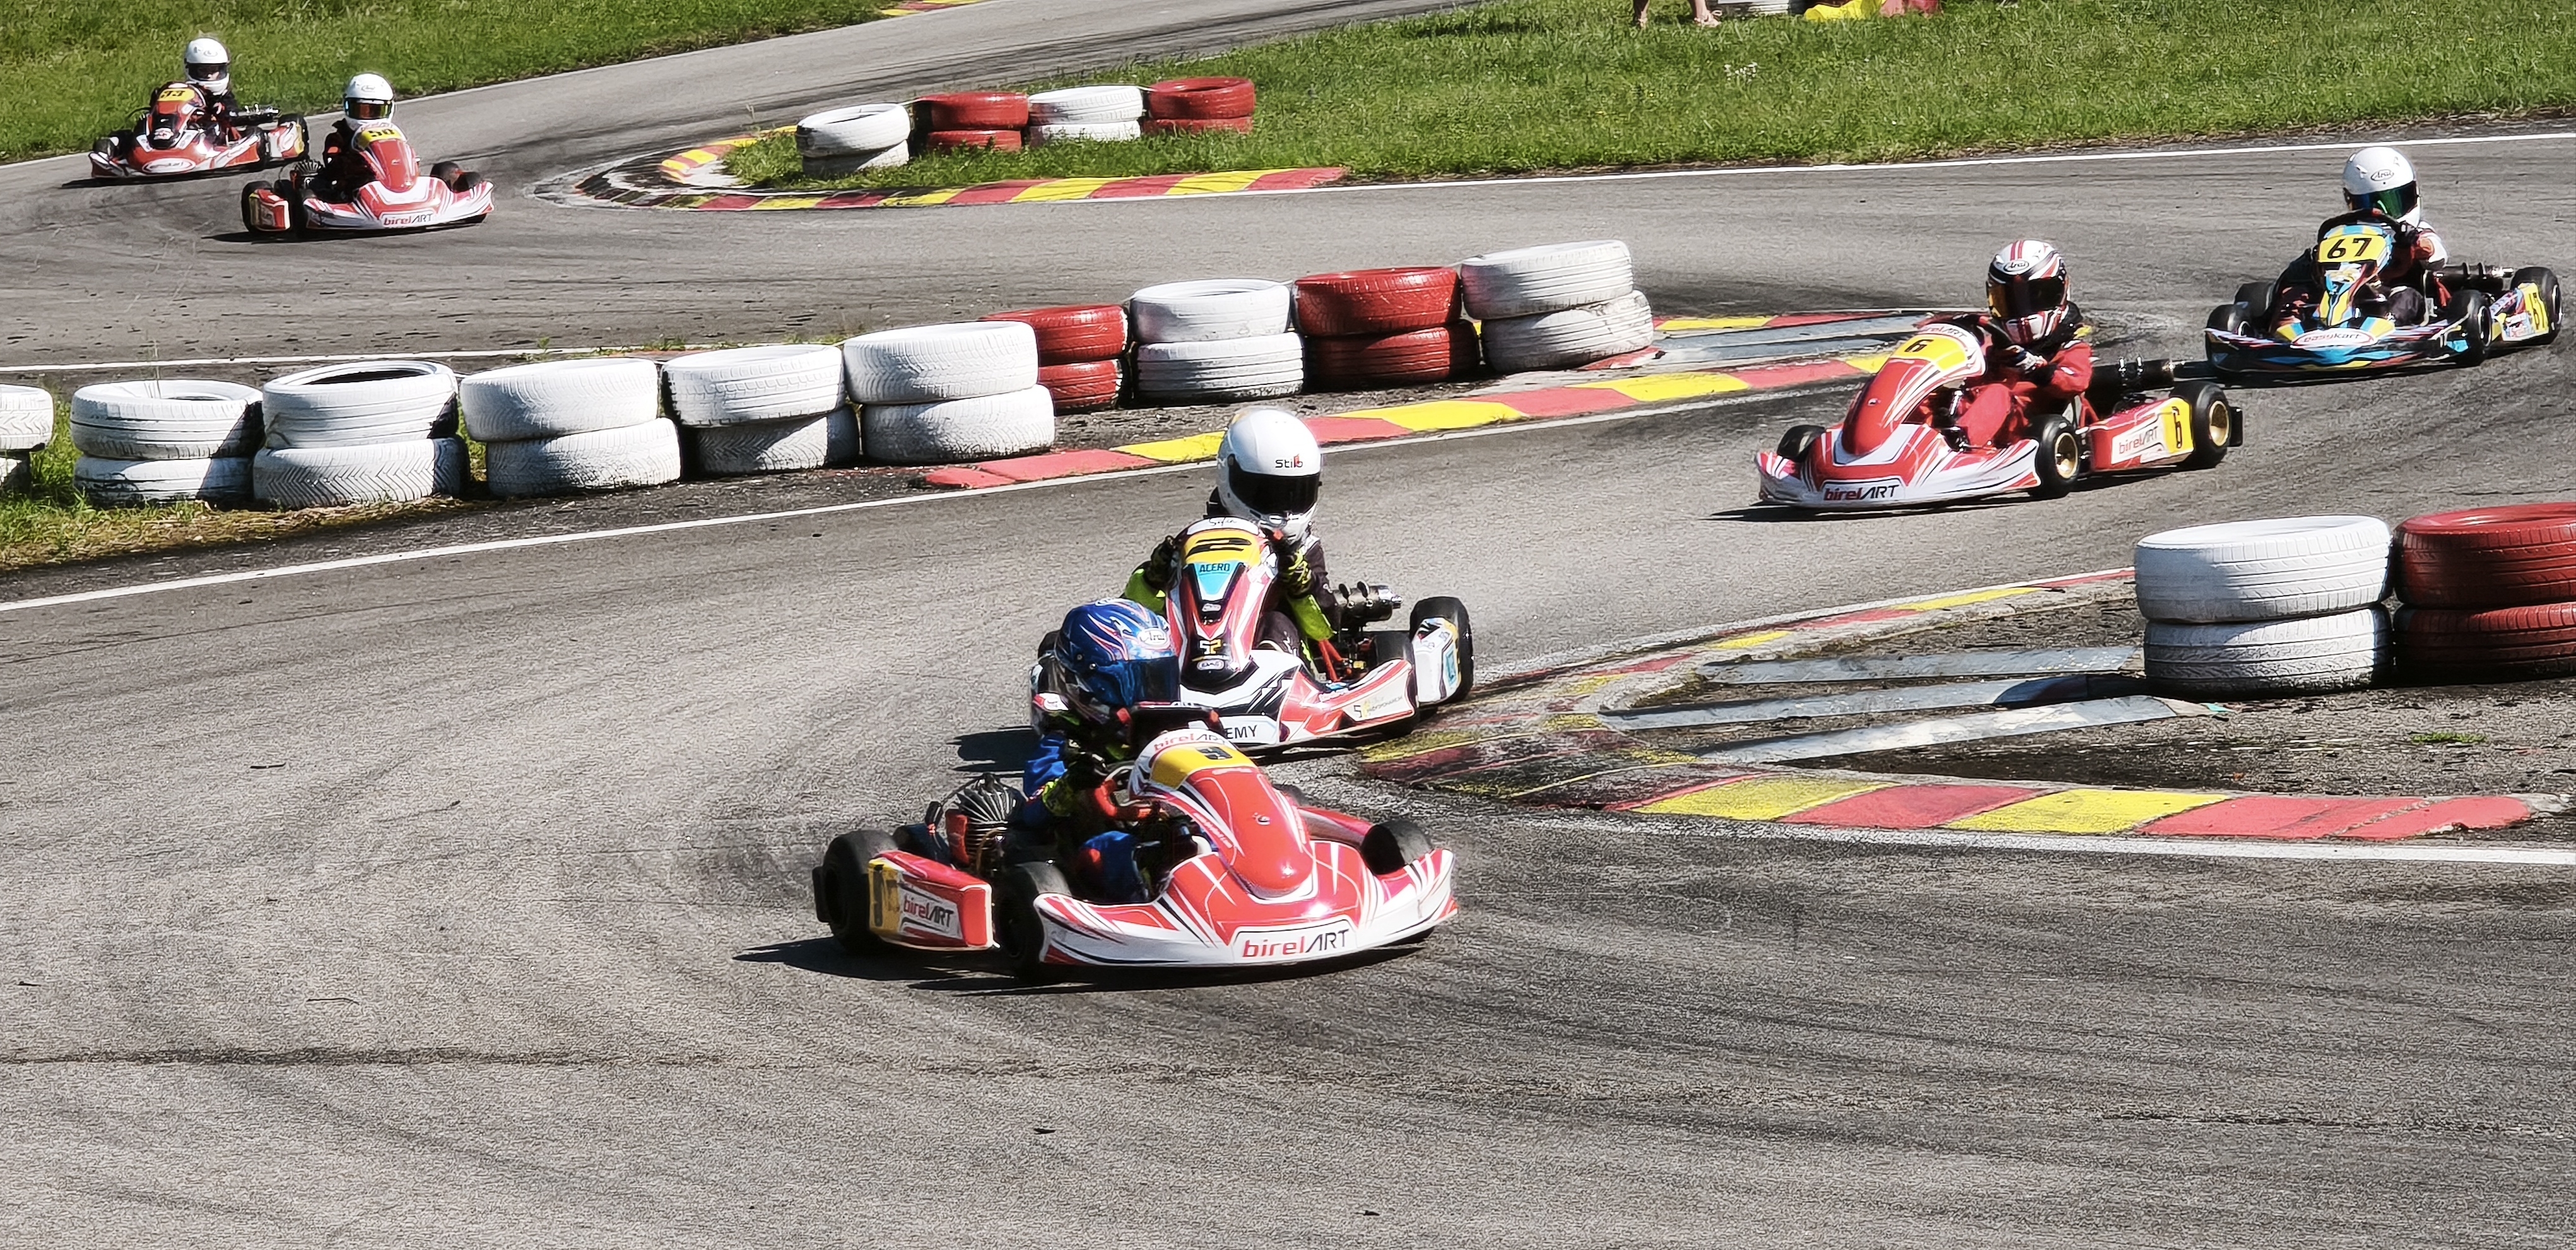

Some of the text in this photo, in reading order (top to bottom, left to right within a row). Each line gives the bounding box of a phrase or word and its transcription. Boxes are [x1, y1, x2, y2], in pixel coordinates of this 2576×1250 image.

[2327, 237, 2372, 259] 67
[1903, 339, 1934, 353] 6
[2171, 406, 2183, 449] 6
[1274, 453, 1303, 468] Stilo
[1823, 484, 1900, 501] birelART
[1185, 537, 1252, 559] 2
[1199, 563, 1231, 573] ACERO
[903, 892, 955, 928] birelART
[1242, 928, 1350, 958] birelART
